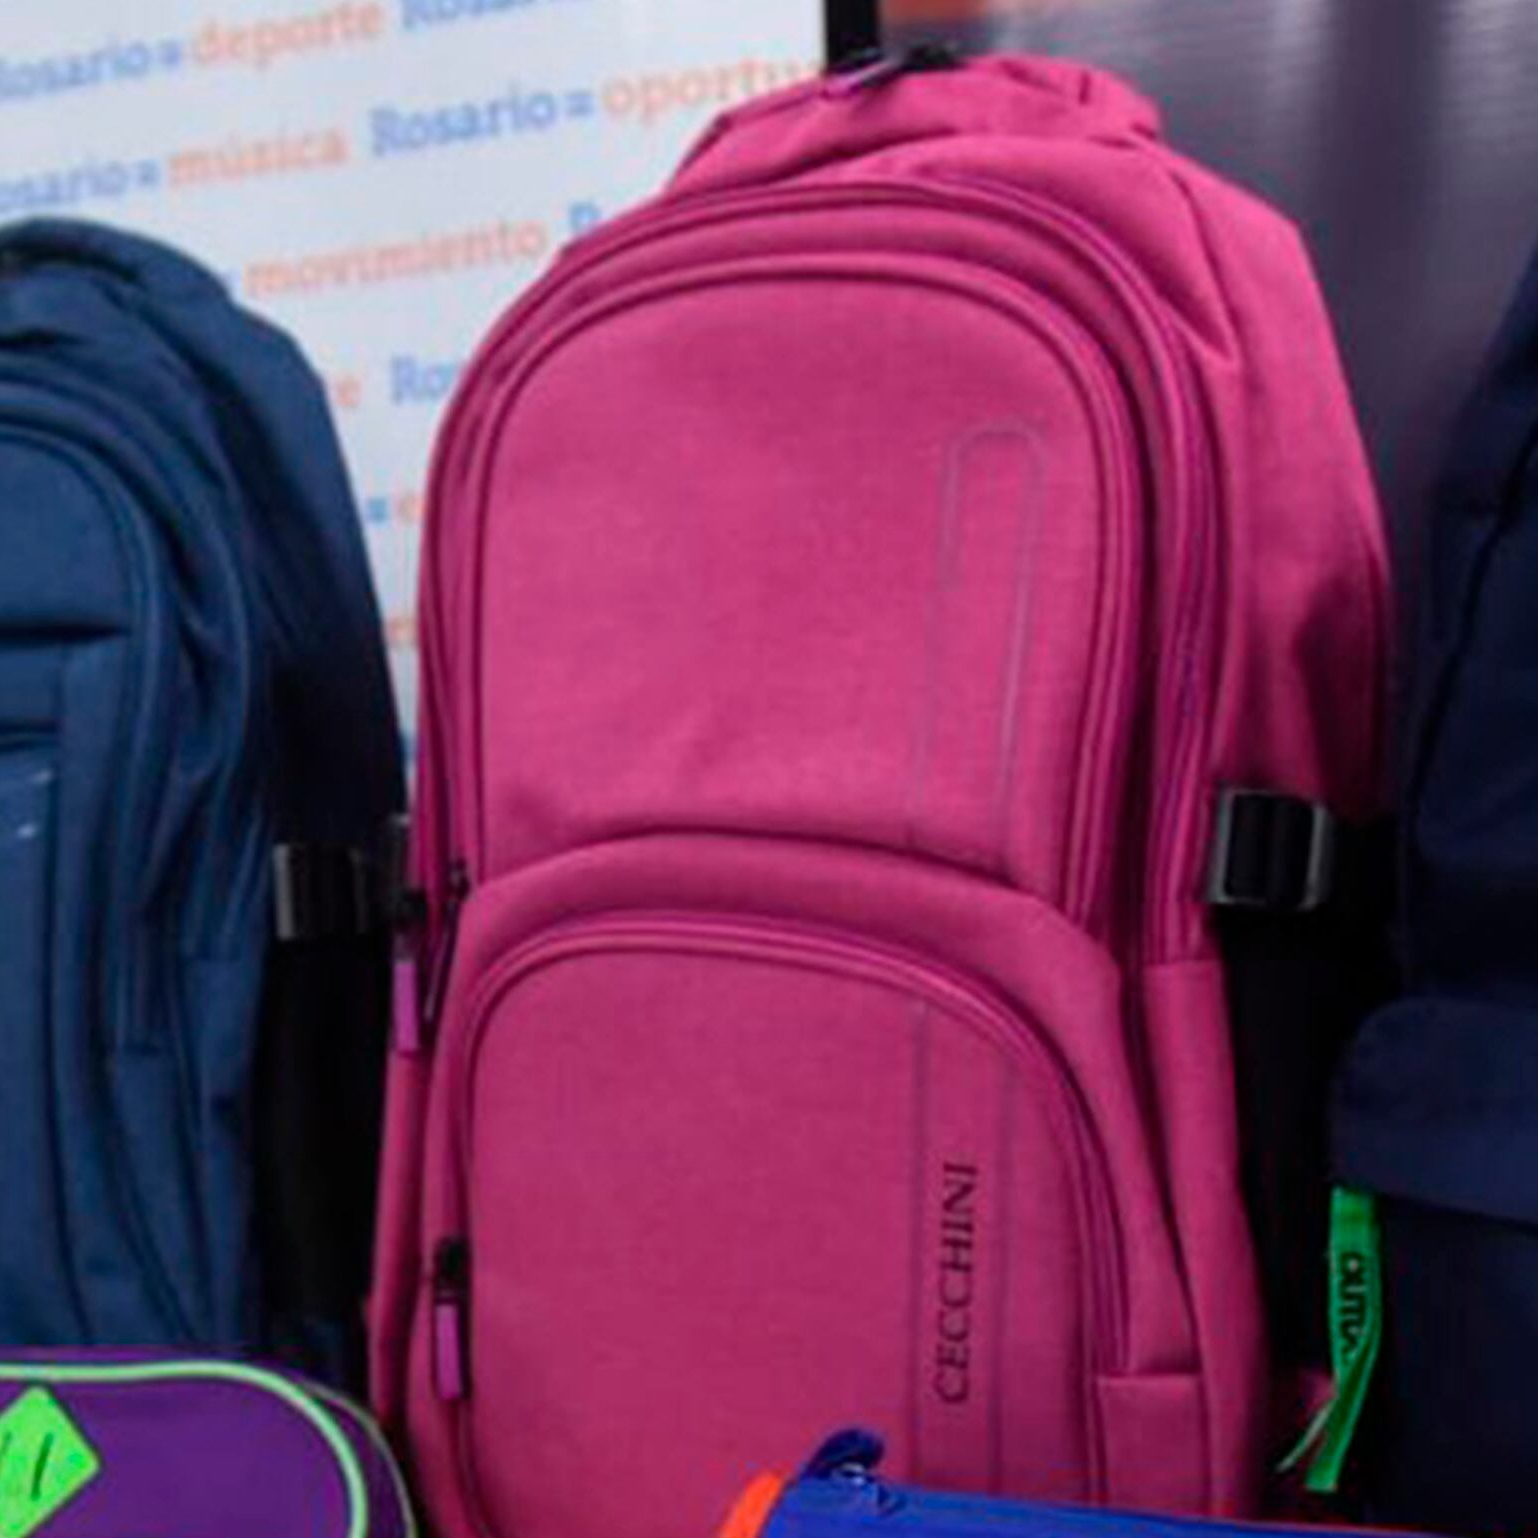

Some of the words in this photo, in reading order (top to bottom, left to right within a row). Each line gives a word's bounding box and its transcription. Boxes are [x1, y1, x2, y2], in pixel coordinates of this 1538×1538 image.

[192, 2, 383, 71] deporte
[169, 126, 348, 188] música
[370, 84, 559, 157] Rosario
[243, 217, 547, 295] movimiento
[934, 1161, 979, 1405] CECCHINI
